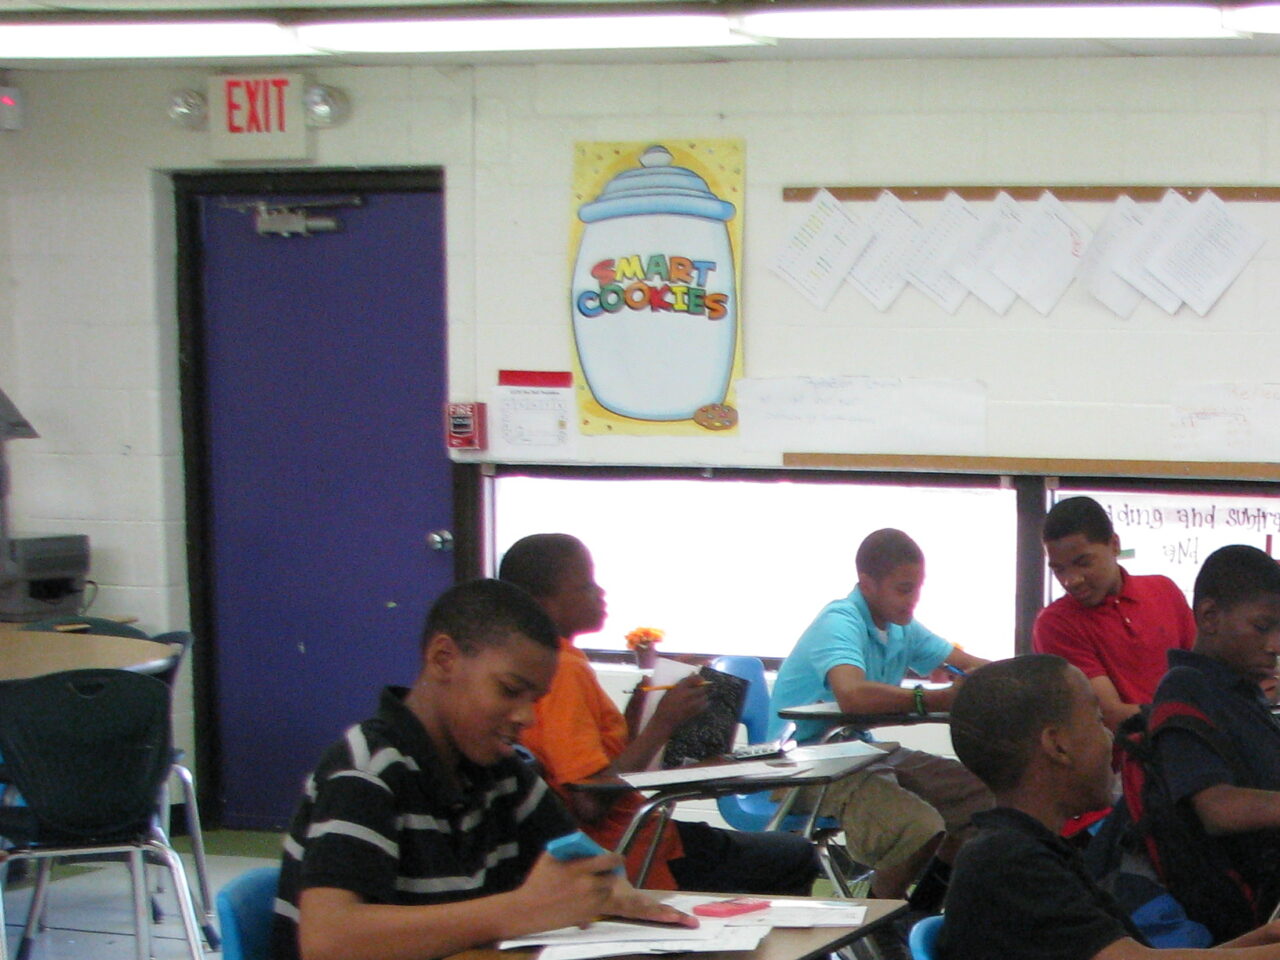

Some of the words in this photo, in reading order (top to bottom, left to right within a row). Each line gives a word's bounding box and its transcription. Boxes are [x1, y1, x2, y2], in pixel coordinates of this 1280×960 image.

[225, 79, 290, 134] EXIT
[591, 254, 717, 291] SMART
[577, 281, 729, 321] COOKIES
[1106, 503, 1164, 529] dding
[1176, 504, 1216, 529] and
